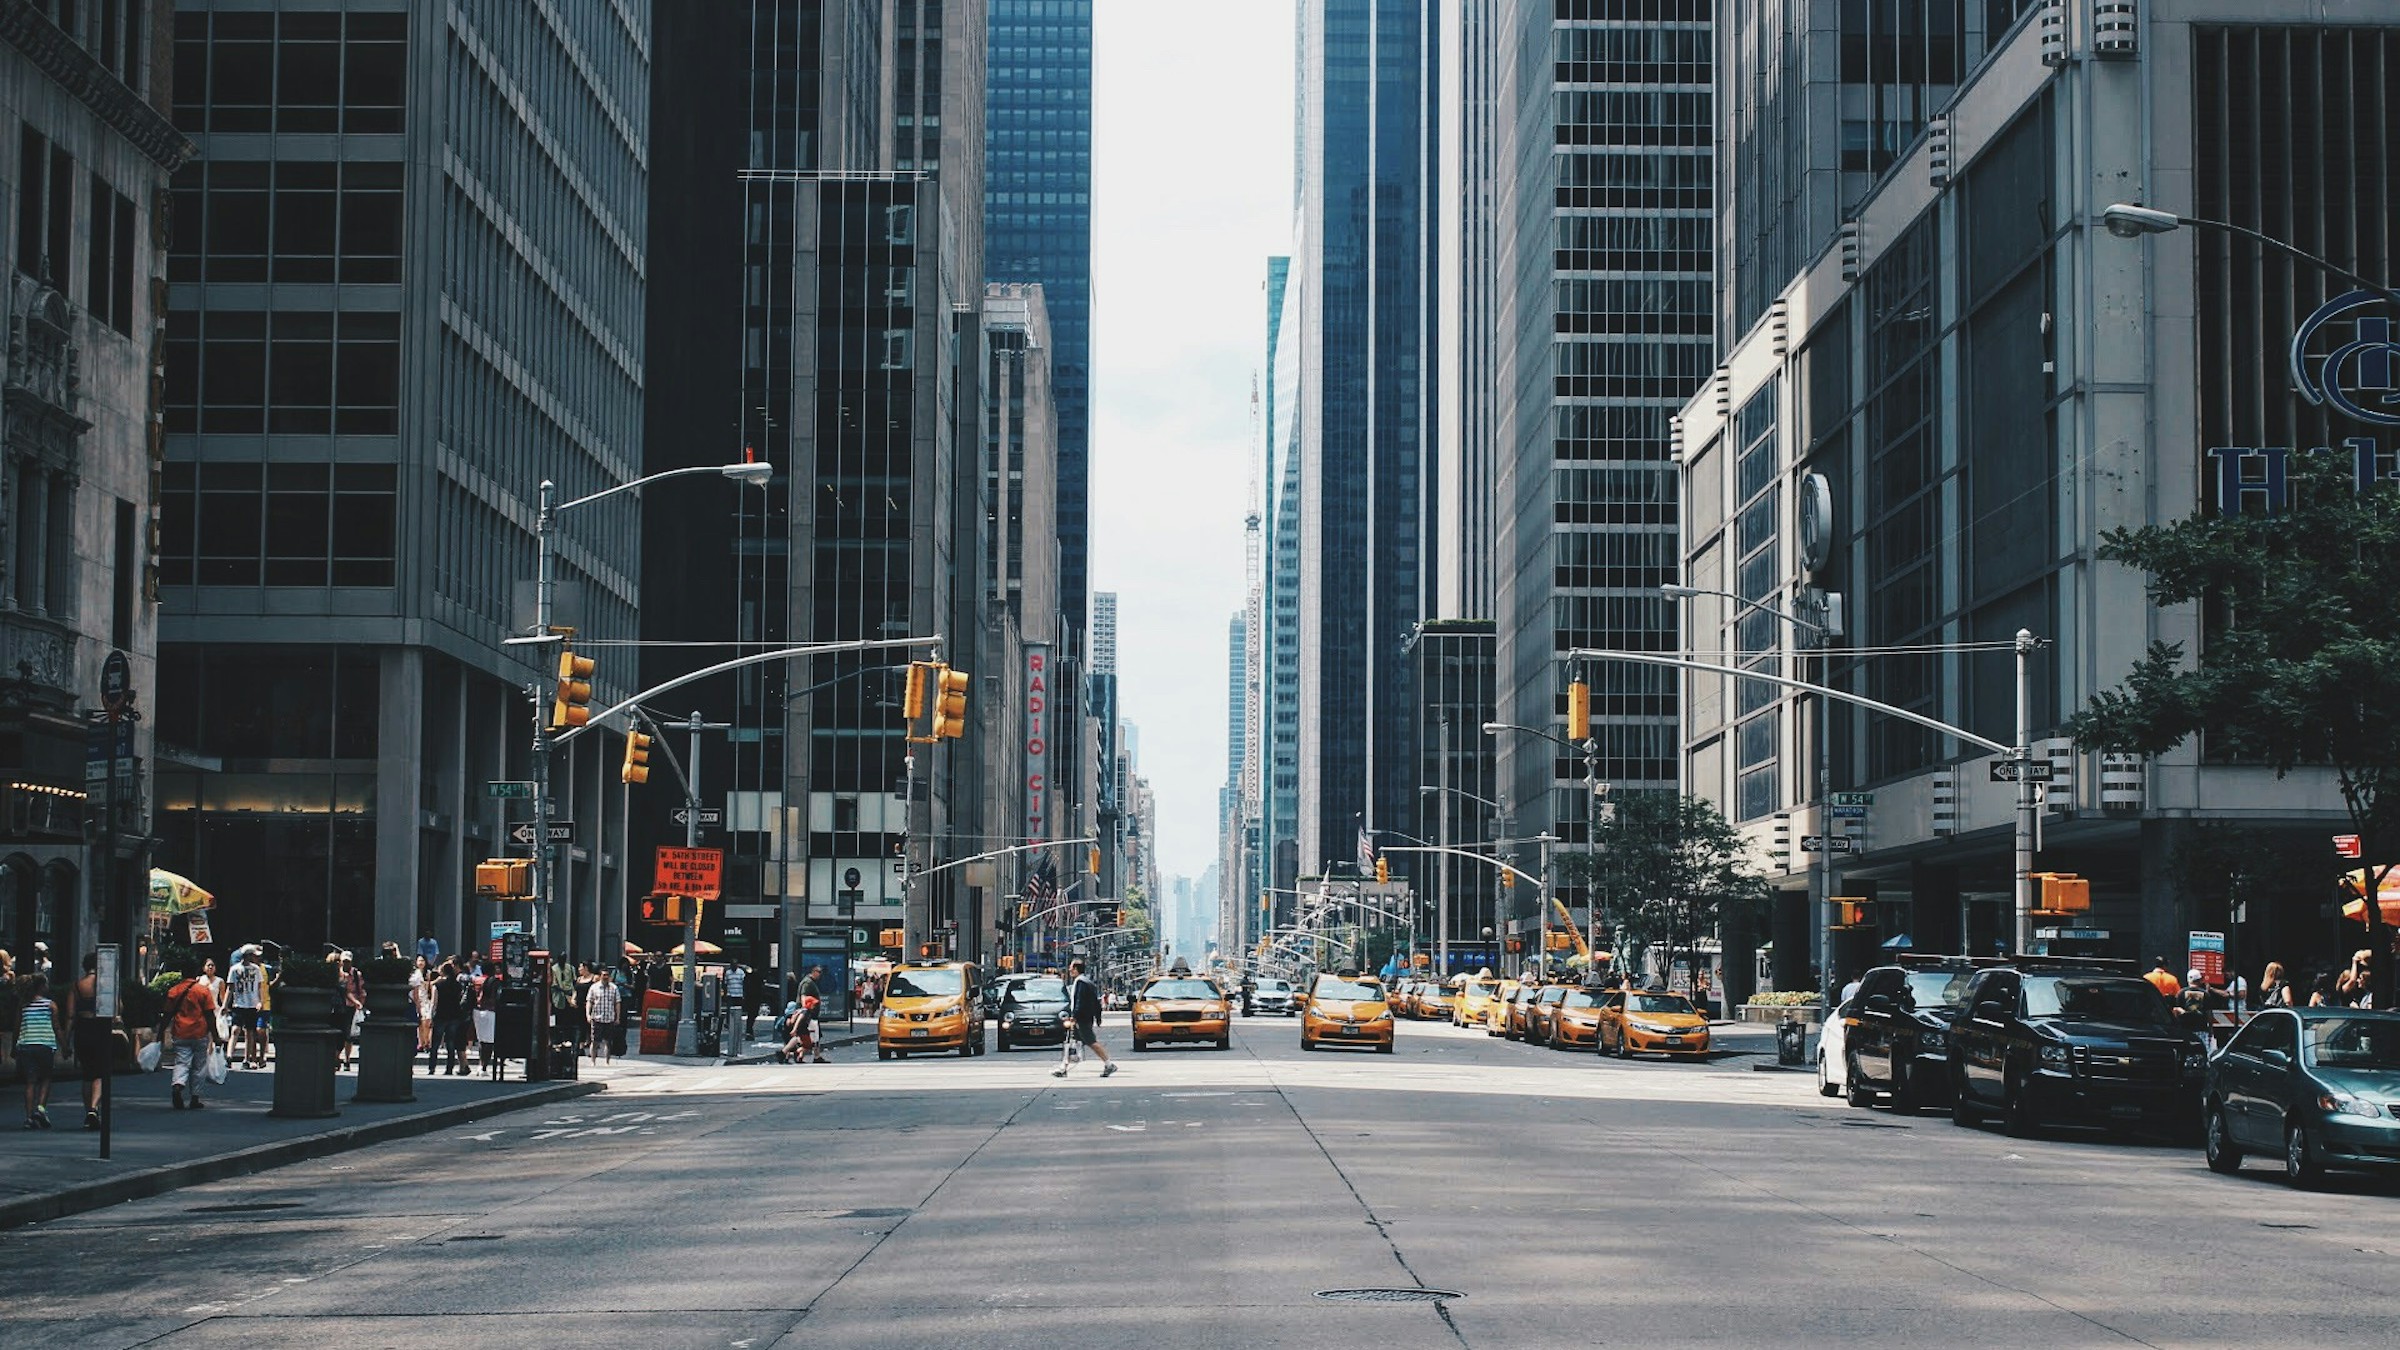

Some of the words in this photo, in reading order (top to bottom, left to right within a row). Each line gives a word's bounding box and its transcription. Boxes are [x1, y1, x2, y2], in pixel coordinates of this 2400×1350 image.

[1028, 655, 1045, 755] RADIO
[2000, 767, 2018, 776] ONE
[490, 784, 498, 796] W
[501, 784, 512, 796] 54
[1852, 794, 1864, 805] 54
[672, 851, 690, 860] 54TH
[692, 852, 719, 861] STREET
[664, 861, 678, 869] WILL
[680, 862, 688, 870] BE
[690, 862, 715, 871] CLOSED
[673, 871, 703, 880] BETWEEN
